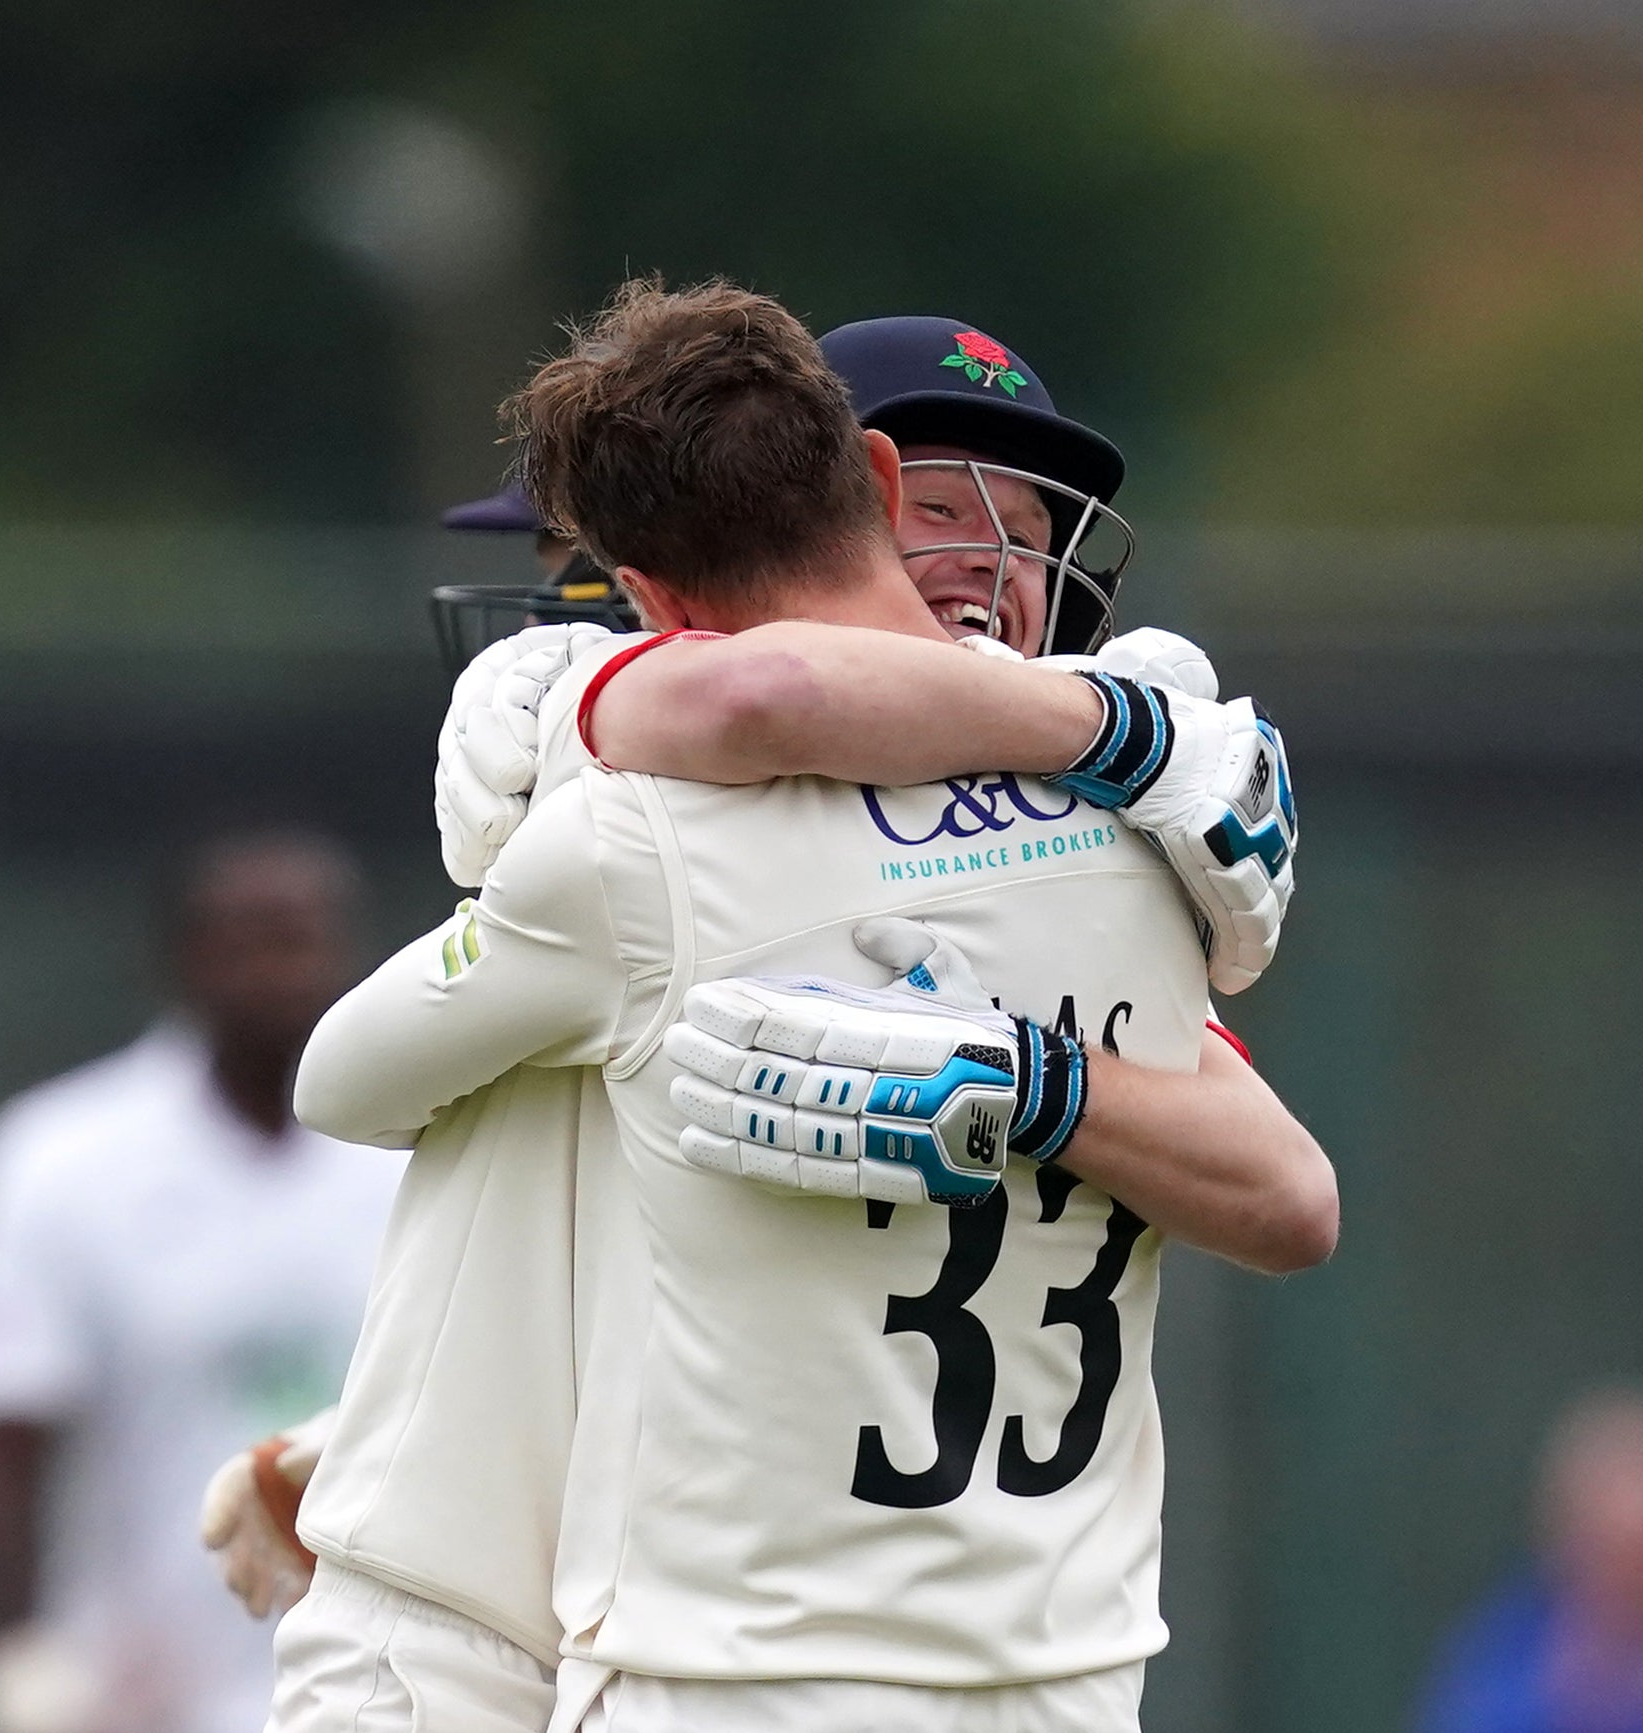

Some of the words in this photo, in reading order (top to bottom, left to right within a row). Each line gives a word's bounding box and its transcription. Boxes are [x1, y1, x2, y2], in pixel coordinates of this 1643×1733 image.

[881, 847, 1010, 881] INSURANCE
[1021, 824, 1117, 862] BROKERS
[850, 1163, 1150, 1508] 33
